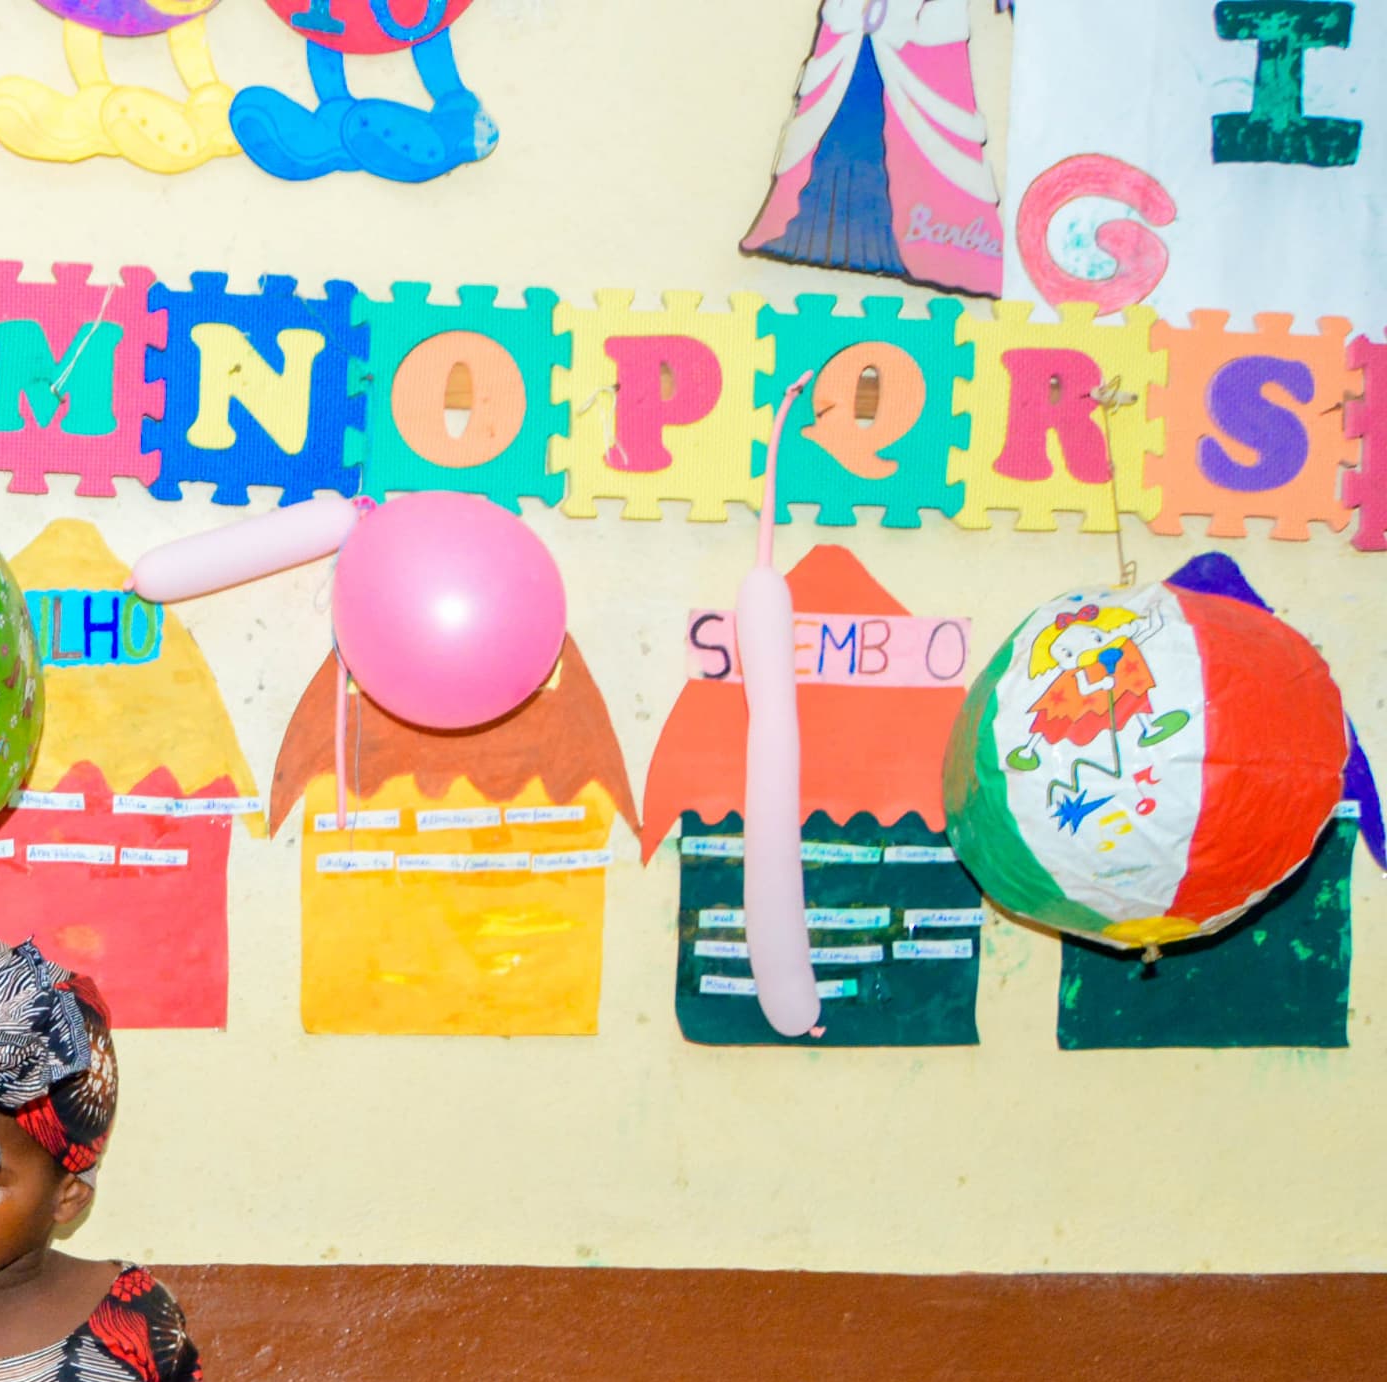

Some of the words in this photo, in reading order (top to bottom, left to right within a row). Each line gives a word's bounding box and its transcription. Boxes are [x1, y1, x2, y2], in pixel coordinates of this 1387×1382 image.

[905, 203, 1003, 258] Barbie
[1015, 153, 1177, 316] G
[186, 323, 325, 454] N
[391, 330, 526, 468] O
[603, 334, 723, 473] P
[800, 341, 927, 480] Q
[992, 347, 1113, 485] R
[1196, 355, 1315, 492] S
